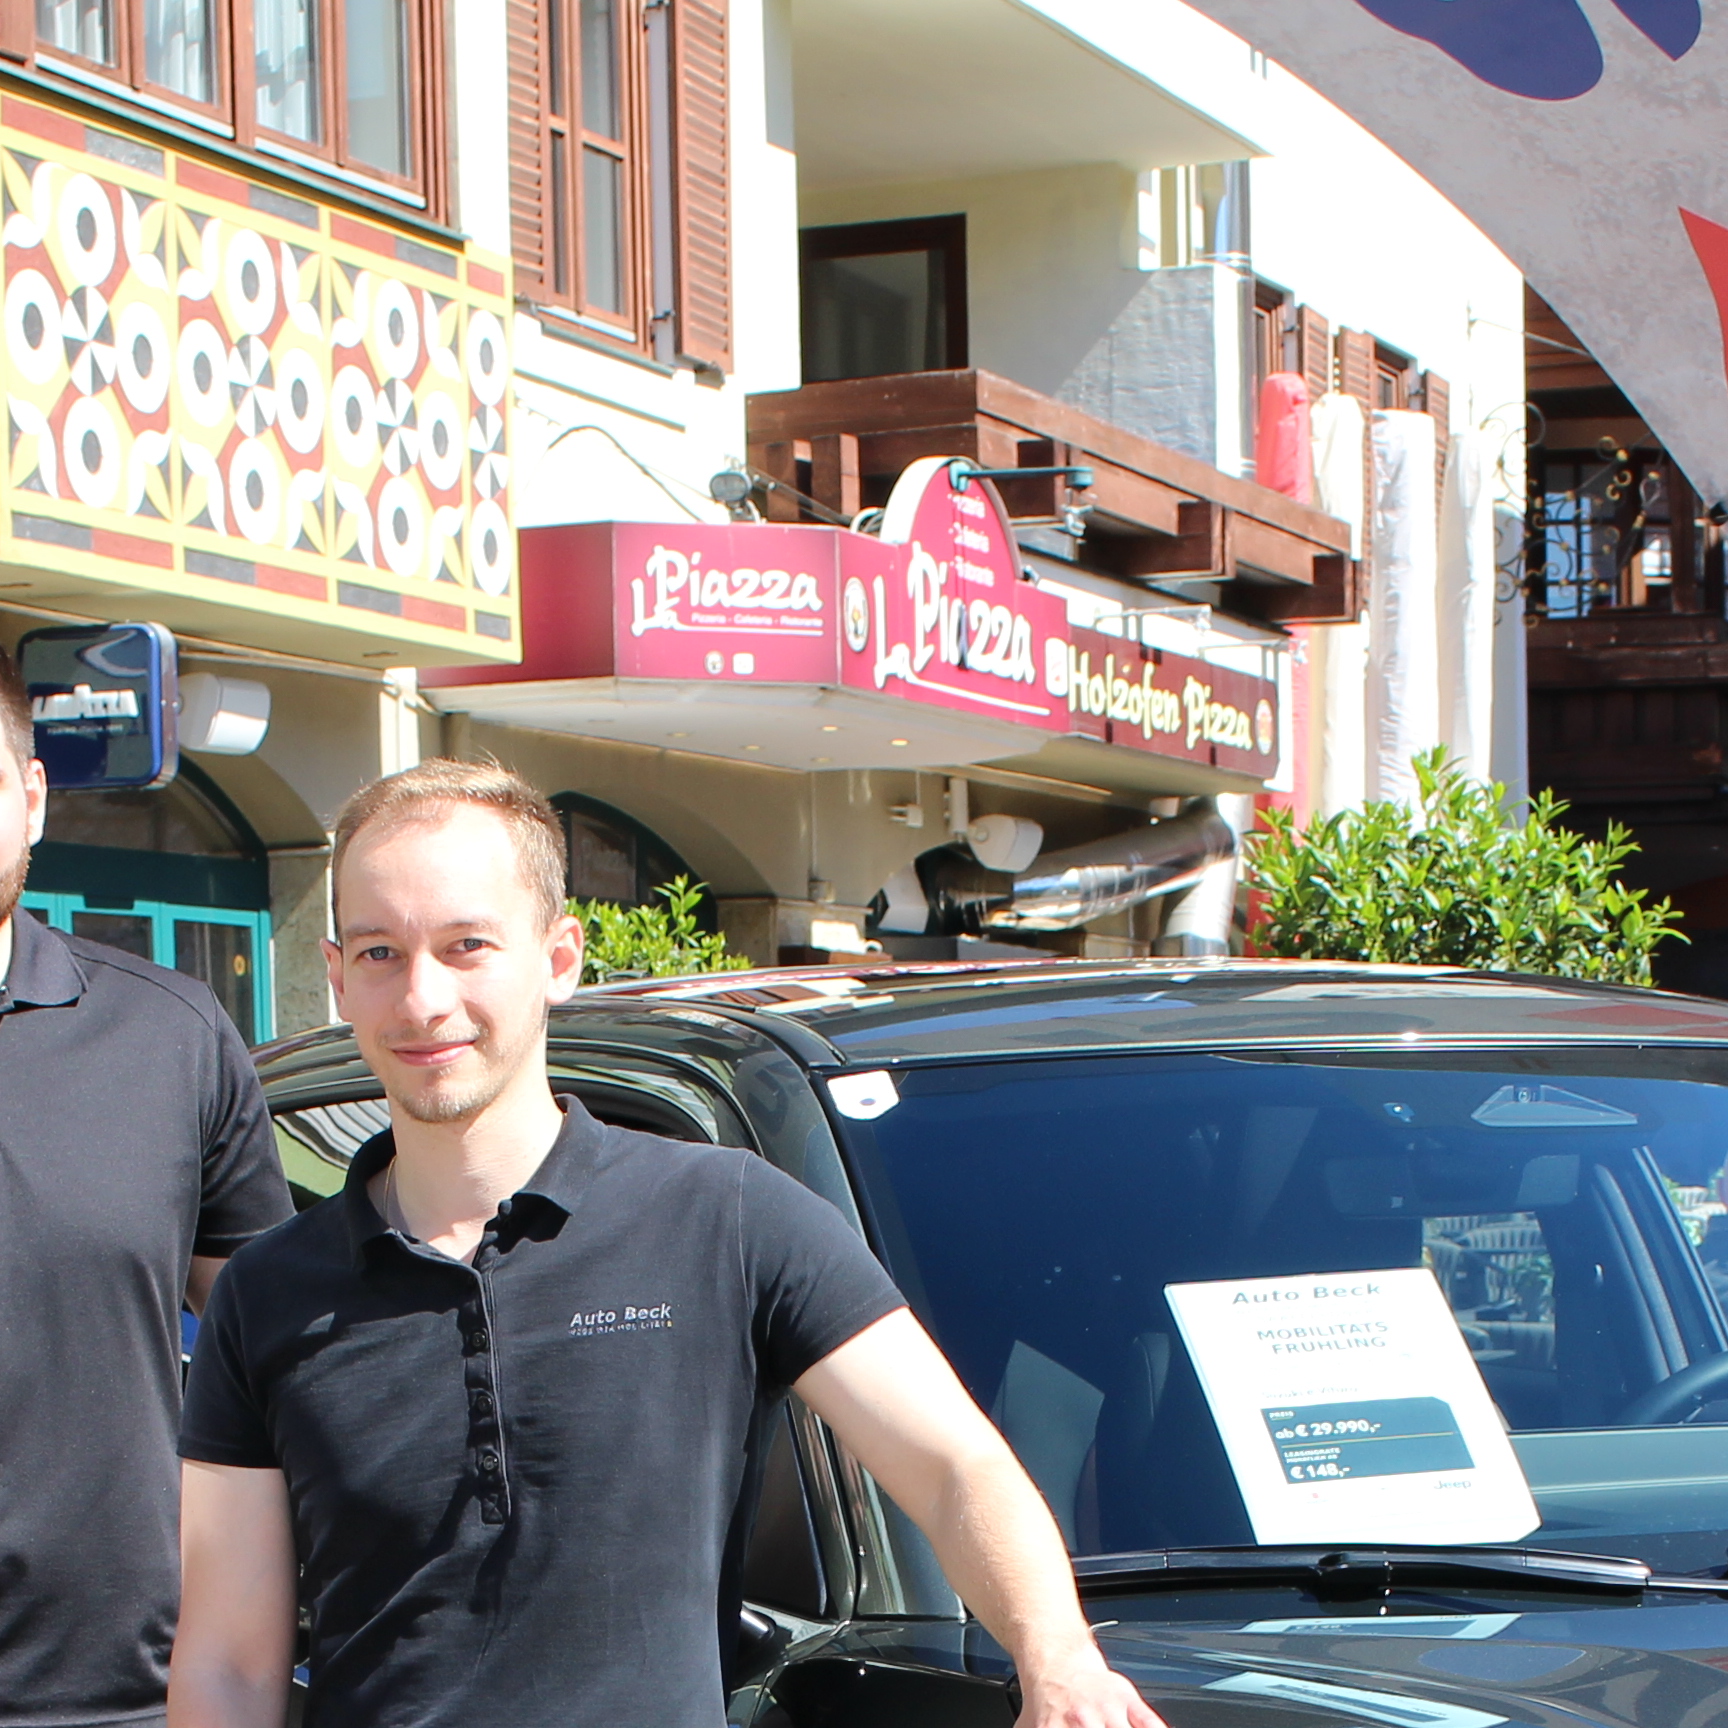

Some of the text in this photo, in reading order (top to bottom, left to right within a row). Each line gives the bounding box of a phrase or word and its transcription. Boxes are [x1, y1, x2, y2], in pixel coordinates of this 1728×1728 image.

[631, 544, 824, 637] La Piazza
[873, 541, 1036, 689] La Piazza
[1068, 645, 1253, 750] Holzofen Pizza
[1232, 1283, 1381, 1305] Auto Beck
[570, 1302, 672, 1328] Auto Beck
[1275, 1419, 1382, 1439] ab € 29.990,-
[1290, 1462, 1351, 1479] € 148,-
[1433, 1480, 1472, 1490] Jeep
